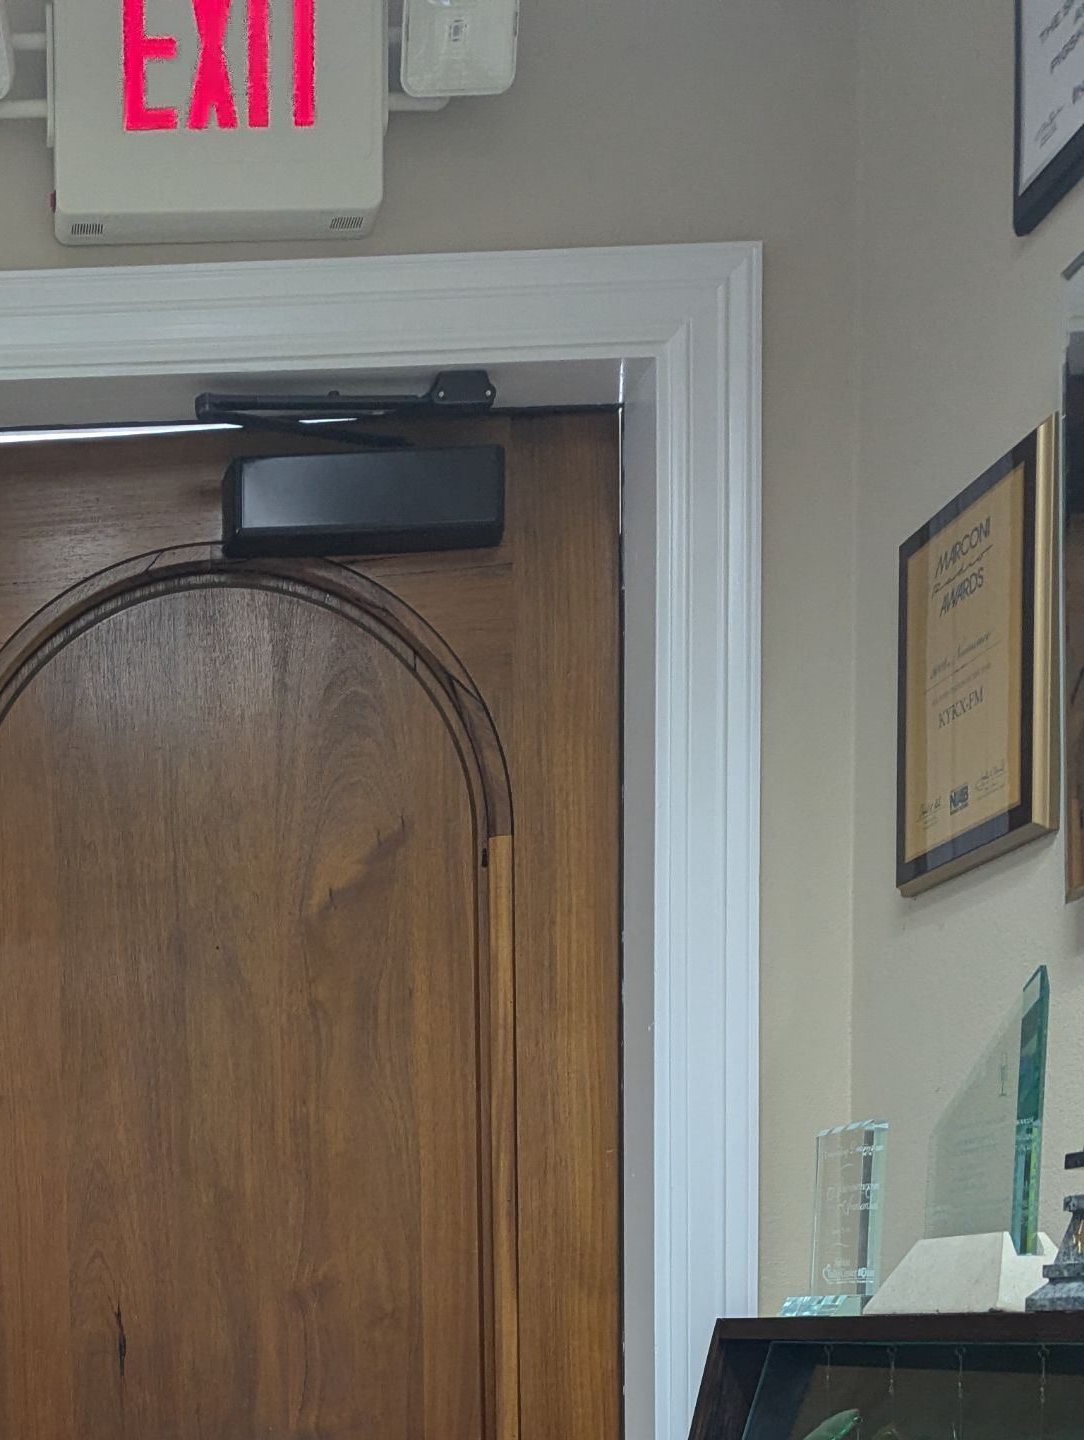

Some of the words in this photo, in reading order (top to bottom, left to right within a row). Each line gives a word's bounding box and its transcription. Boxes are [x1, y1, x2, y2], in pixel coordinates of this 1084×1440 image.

[122, 0, 316, 131] EXIT
[934, 516, 992, 578] MARCONI
[939, 566, 985, 618] AWARDS
